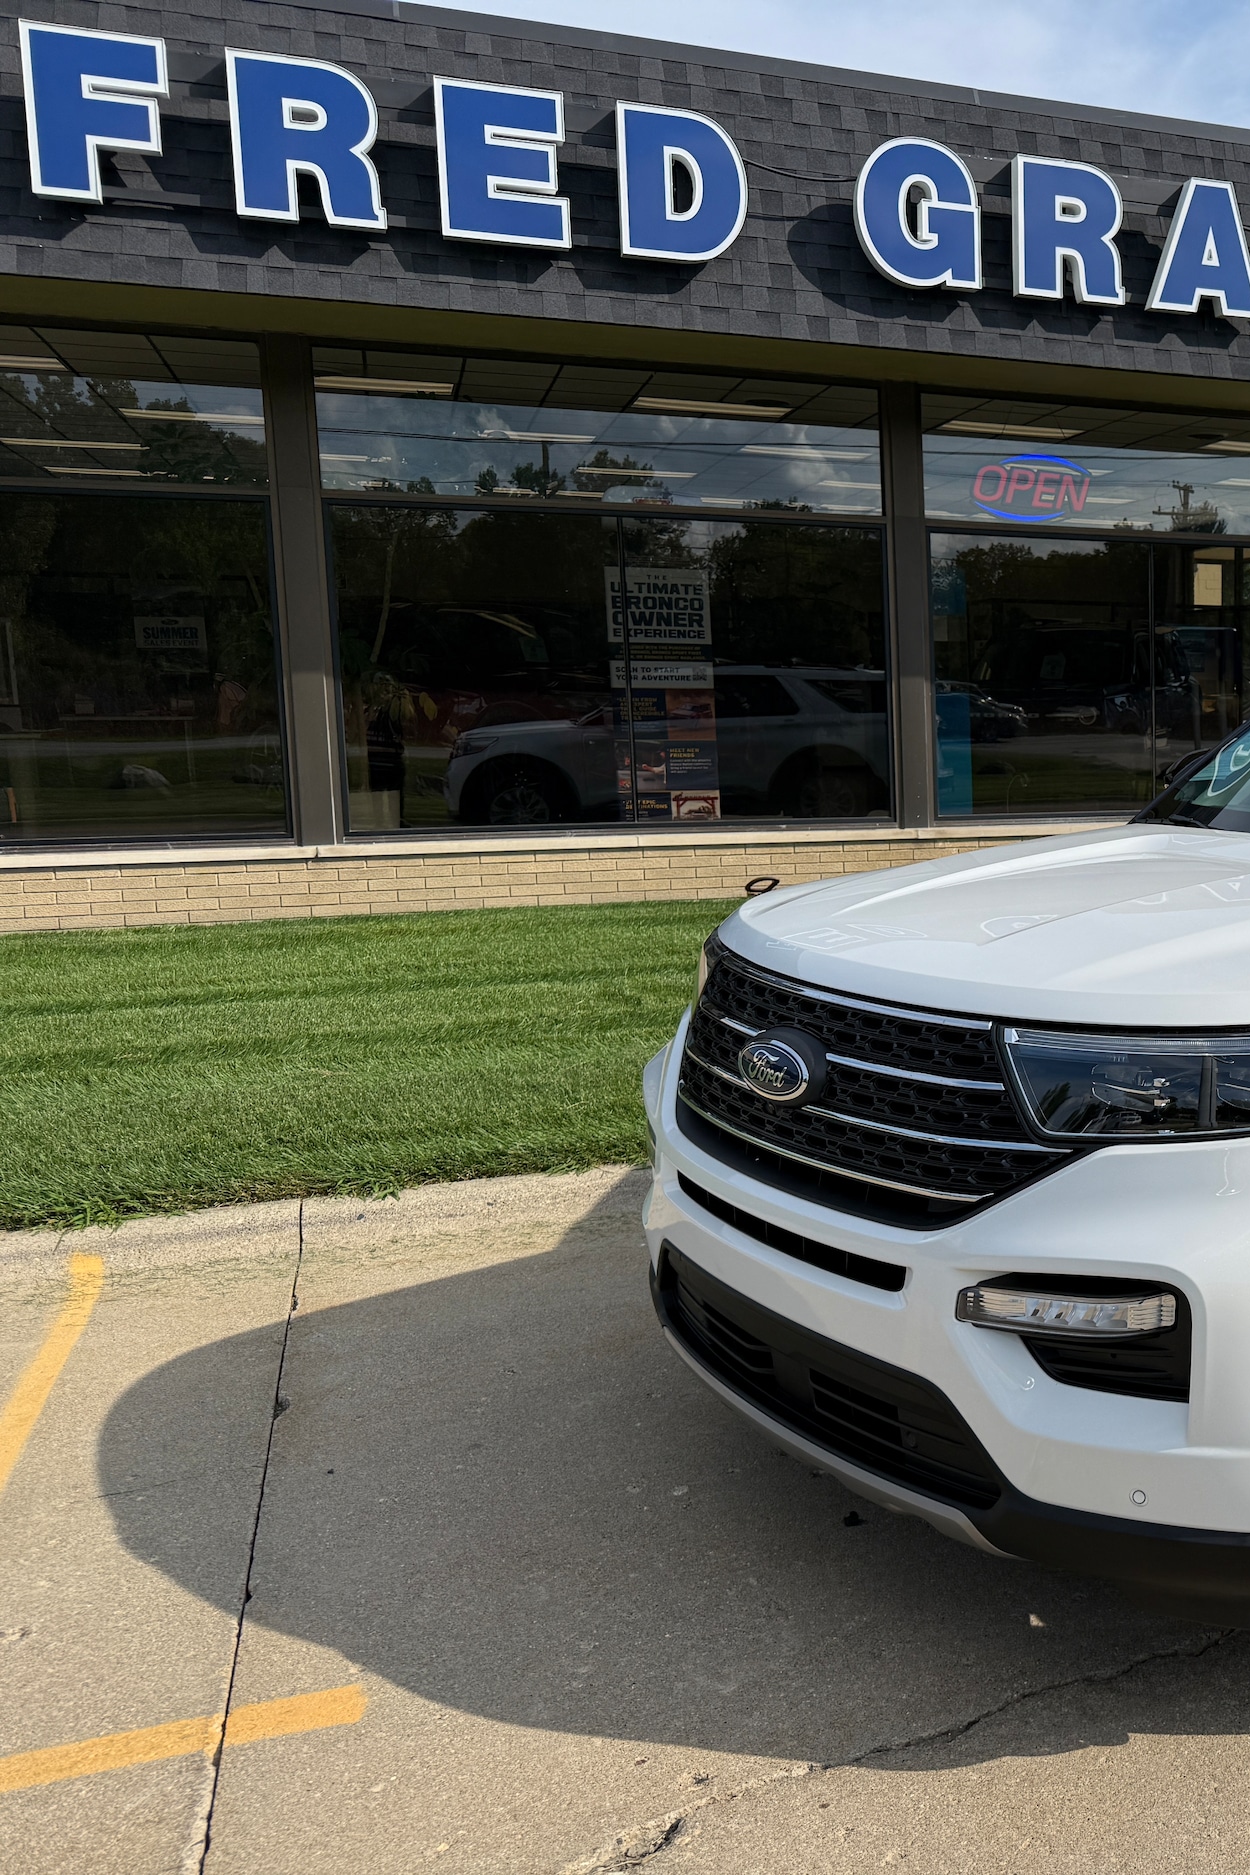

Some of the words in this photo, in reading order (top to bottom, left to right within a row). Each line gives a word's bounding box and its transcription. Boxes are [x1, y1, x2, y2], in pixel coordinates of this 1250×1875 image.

[18, 18, 748, 264] FRED
[973, 465, 1091, 512] OPEN
[611, 595, 704, 611] BRONCO
[612, 611, 704, 628] OWNER
[143, 626, 198, 639] SUMMER
[641, 674, 691, 682] ADVENTURE
[748, 1049, 788, 1088] Ford
